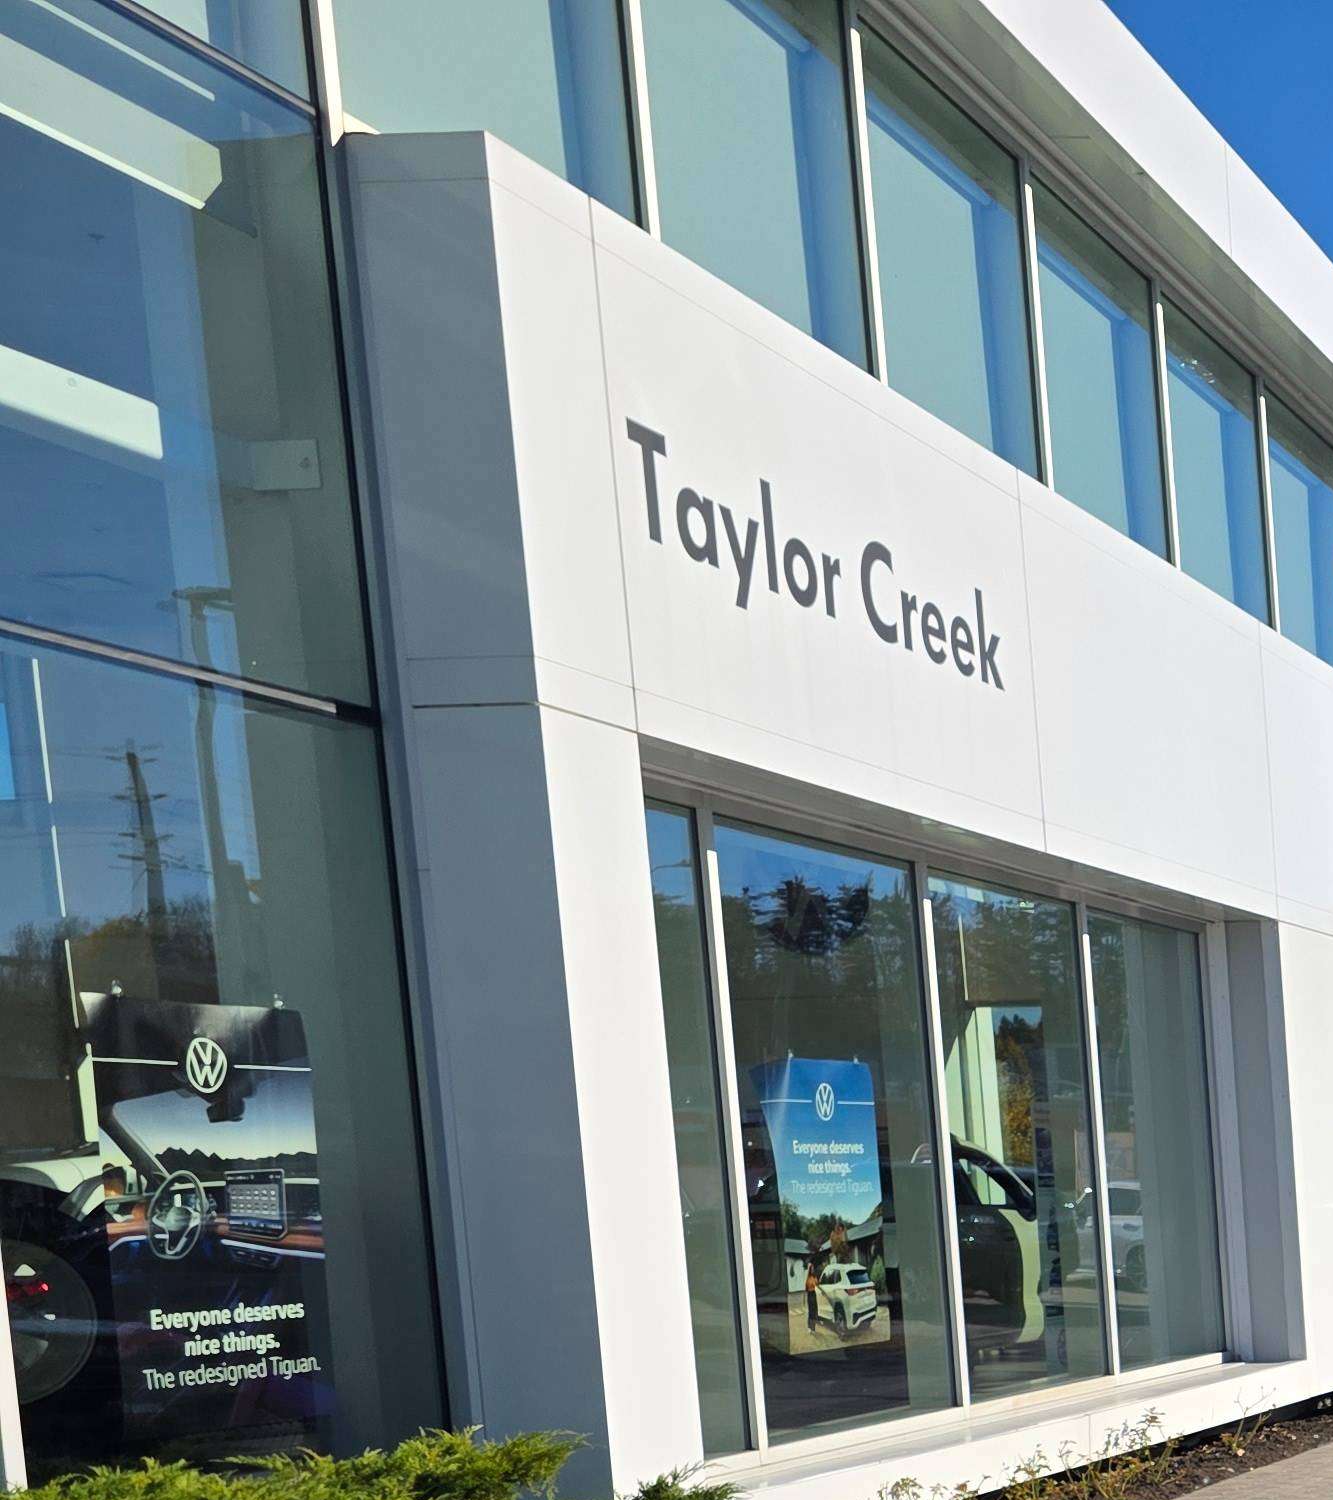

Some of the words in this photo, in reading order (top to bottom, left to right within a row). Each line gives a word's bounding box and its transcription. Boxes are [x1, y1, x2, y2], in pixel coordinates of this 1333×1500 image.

[626, 416, 842, 619] Taylor
[861, 541, 1005, 691] Creek
[792, 1140, 829, 1158] Everyone
[829, 1140, 865, 1155] deserves
[808, 1160, 824, 1174] nice
[825, 1160, 851, 1176] things.
[791, 1181, 806, 1194] The
[806, 1180, 847, 1197] redesigned
[150, 1308, 232, 1332] Everyone
[233, 1302, 305, 1324] deserves
[184, 1334, 221, 1357] nice
[221, 1330, 281, 1355] things.
[142, 1367, 176, 1390] The
[178, 1357, 268, 1387] redesigned
[268, 1356, 322, 1380] Tiguan.
